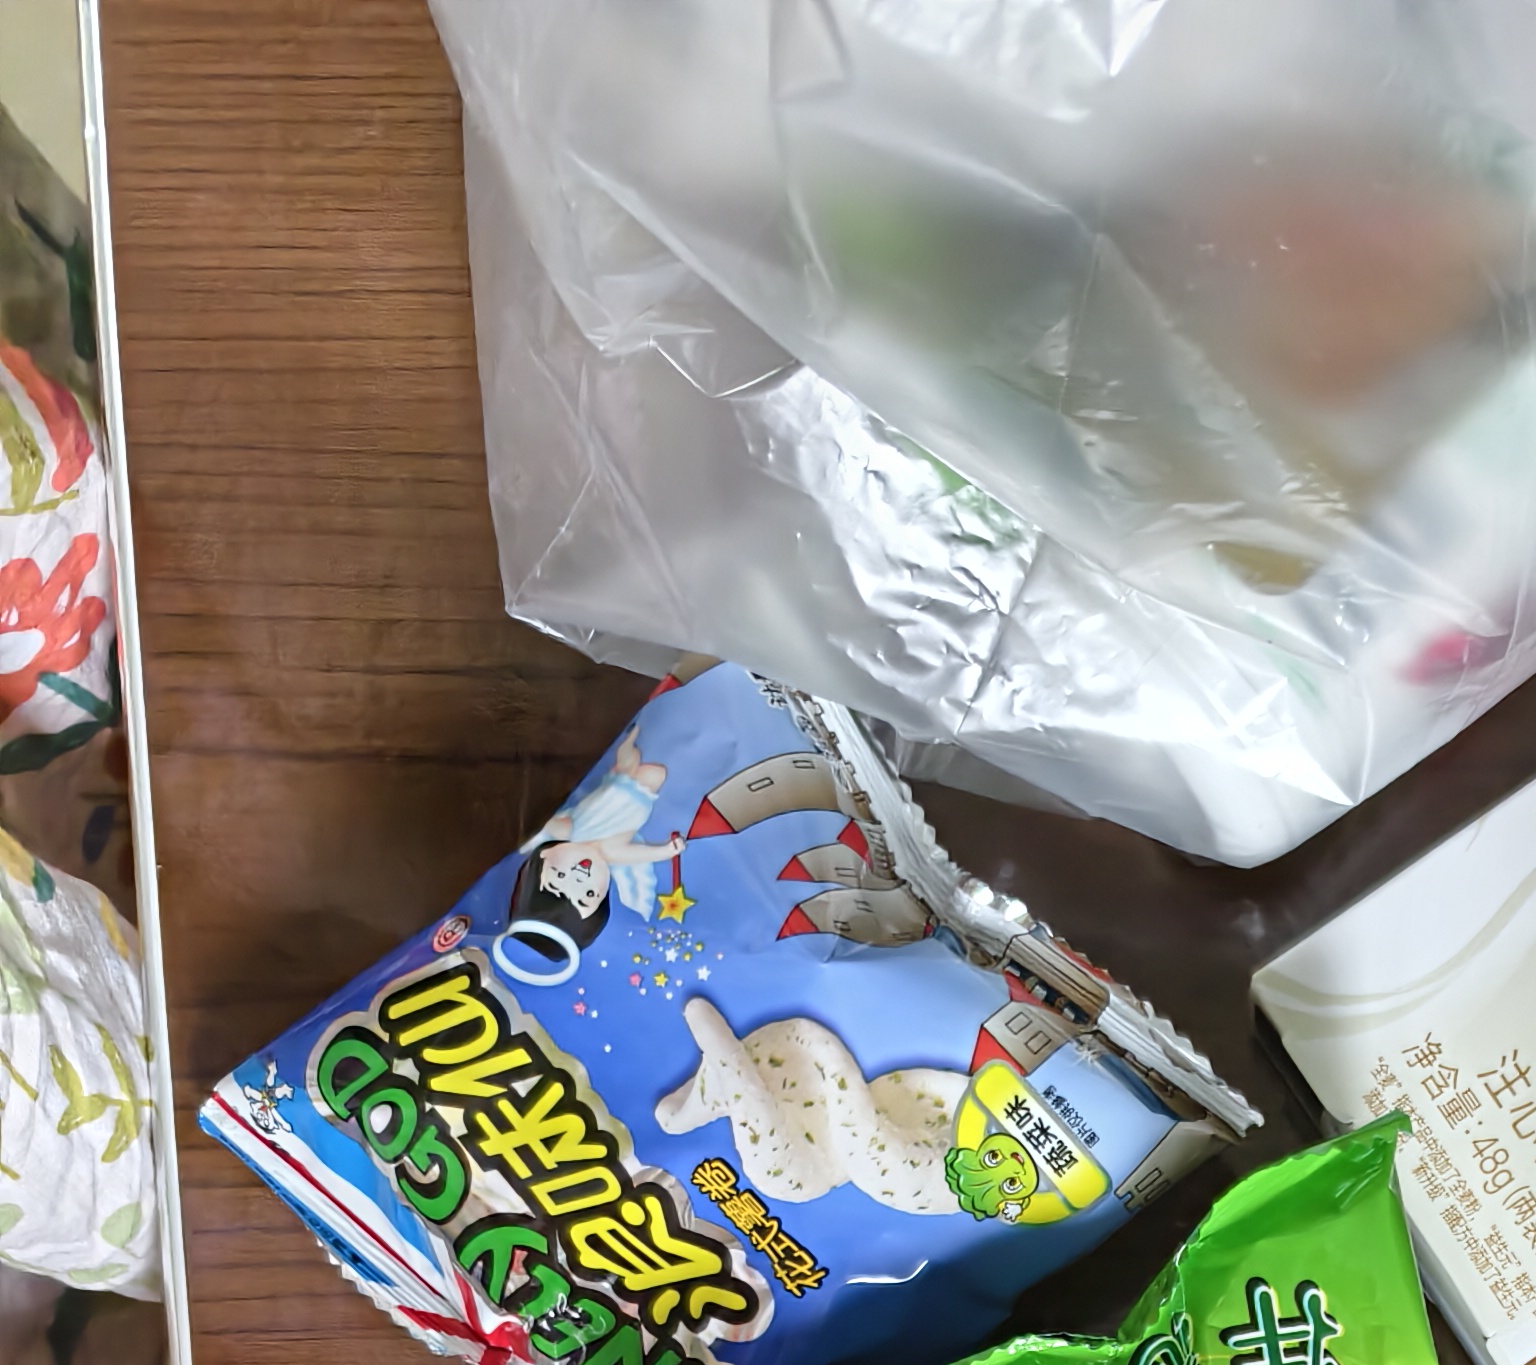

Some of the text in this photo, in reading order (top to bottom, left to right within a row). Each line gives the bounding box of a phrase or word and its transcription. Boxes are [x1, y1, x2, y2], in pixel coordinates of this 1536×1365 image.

[316, 1036, 470, 1223] GOD
[385, 970, 750, 1328] 浪味仙
[1003, 1094, 1080, 1179] 蔬菜味
[688, 1156, 831, 1298] 花式薯卷
